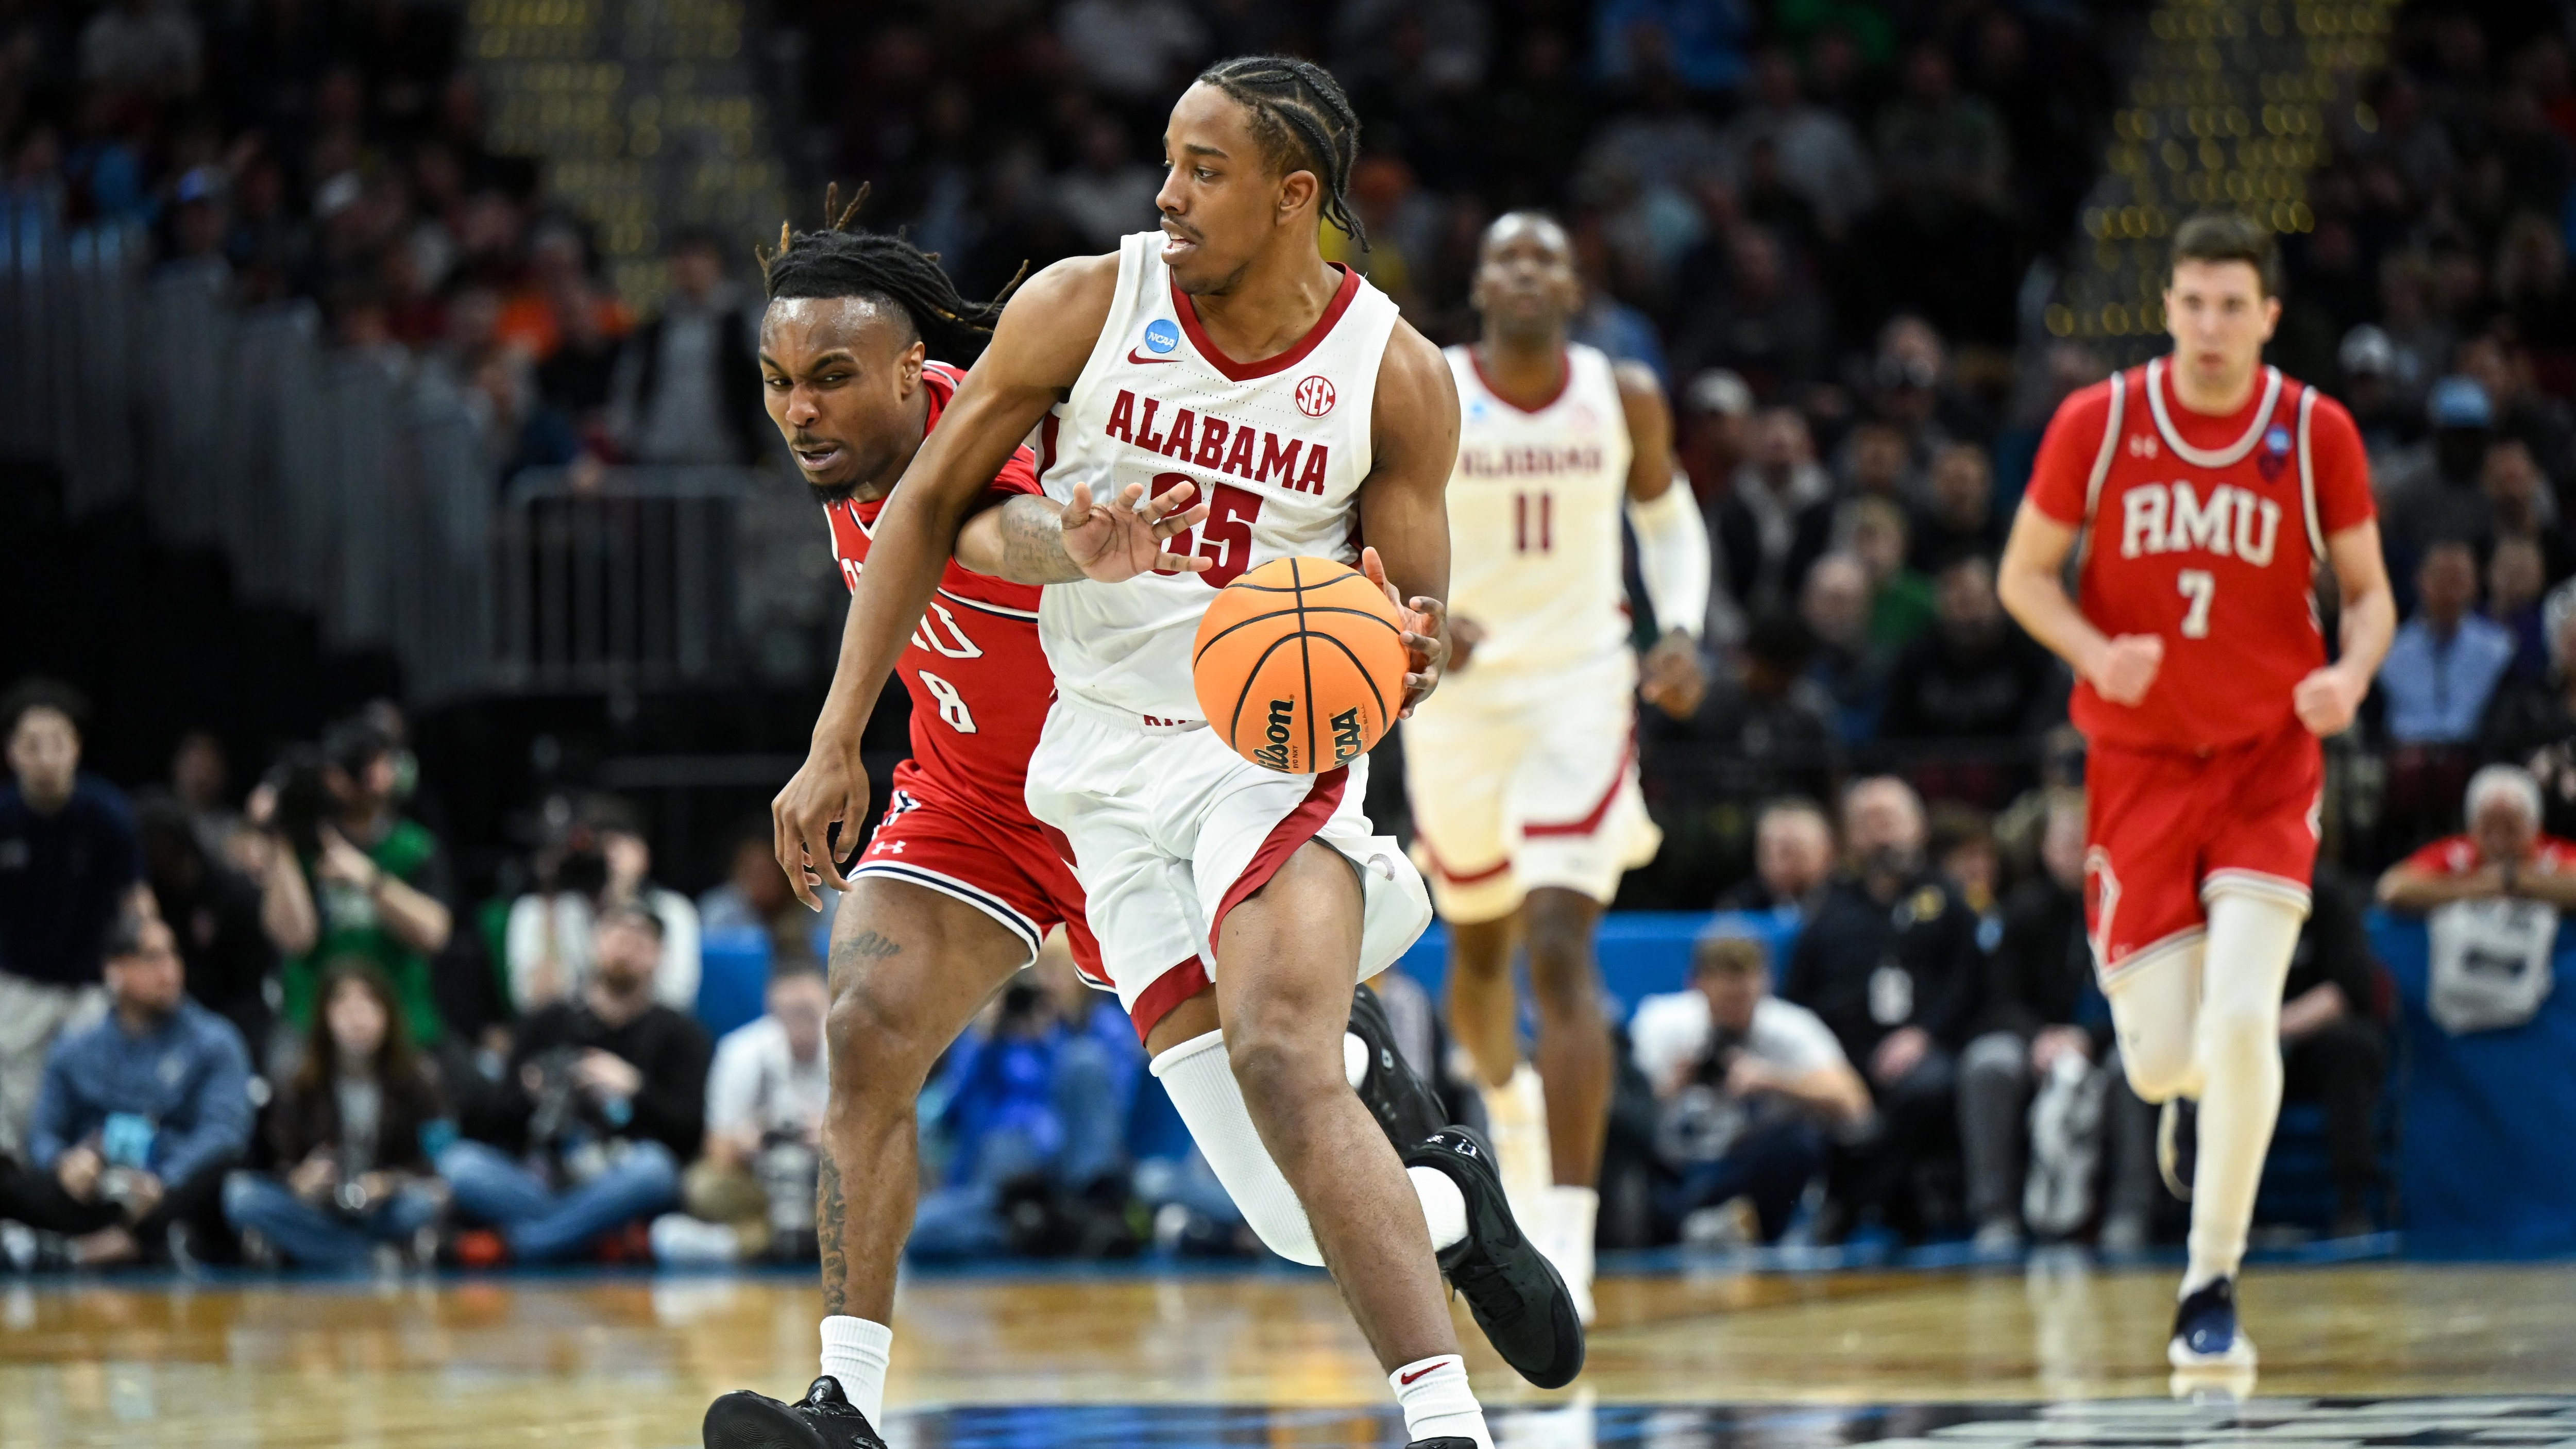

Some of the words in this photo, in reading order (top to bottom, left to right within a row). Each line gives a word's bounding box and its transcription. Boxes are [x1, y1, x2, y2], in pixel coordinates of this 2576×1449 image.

[1148, 331, 1175, 348] NCAA
[1298, 380, 1334, 414] SEC
[1106, 389, 1329, 495] ALABAMA
[1461, 448, 1603, 479] ALABAMA
[1515, 490, 1553, 554] 11
[2121, 480, 2282, 567] RMU
[2178, 569, 2215, 639] 7
[918, 669, 978, 734] 8
